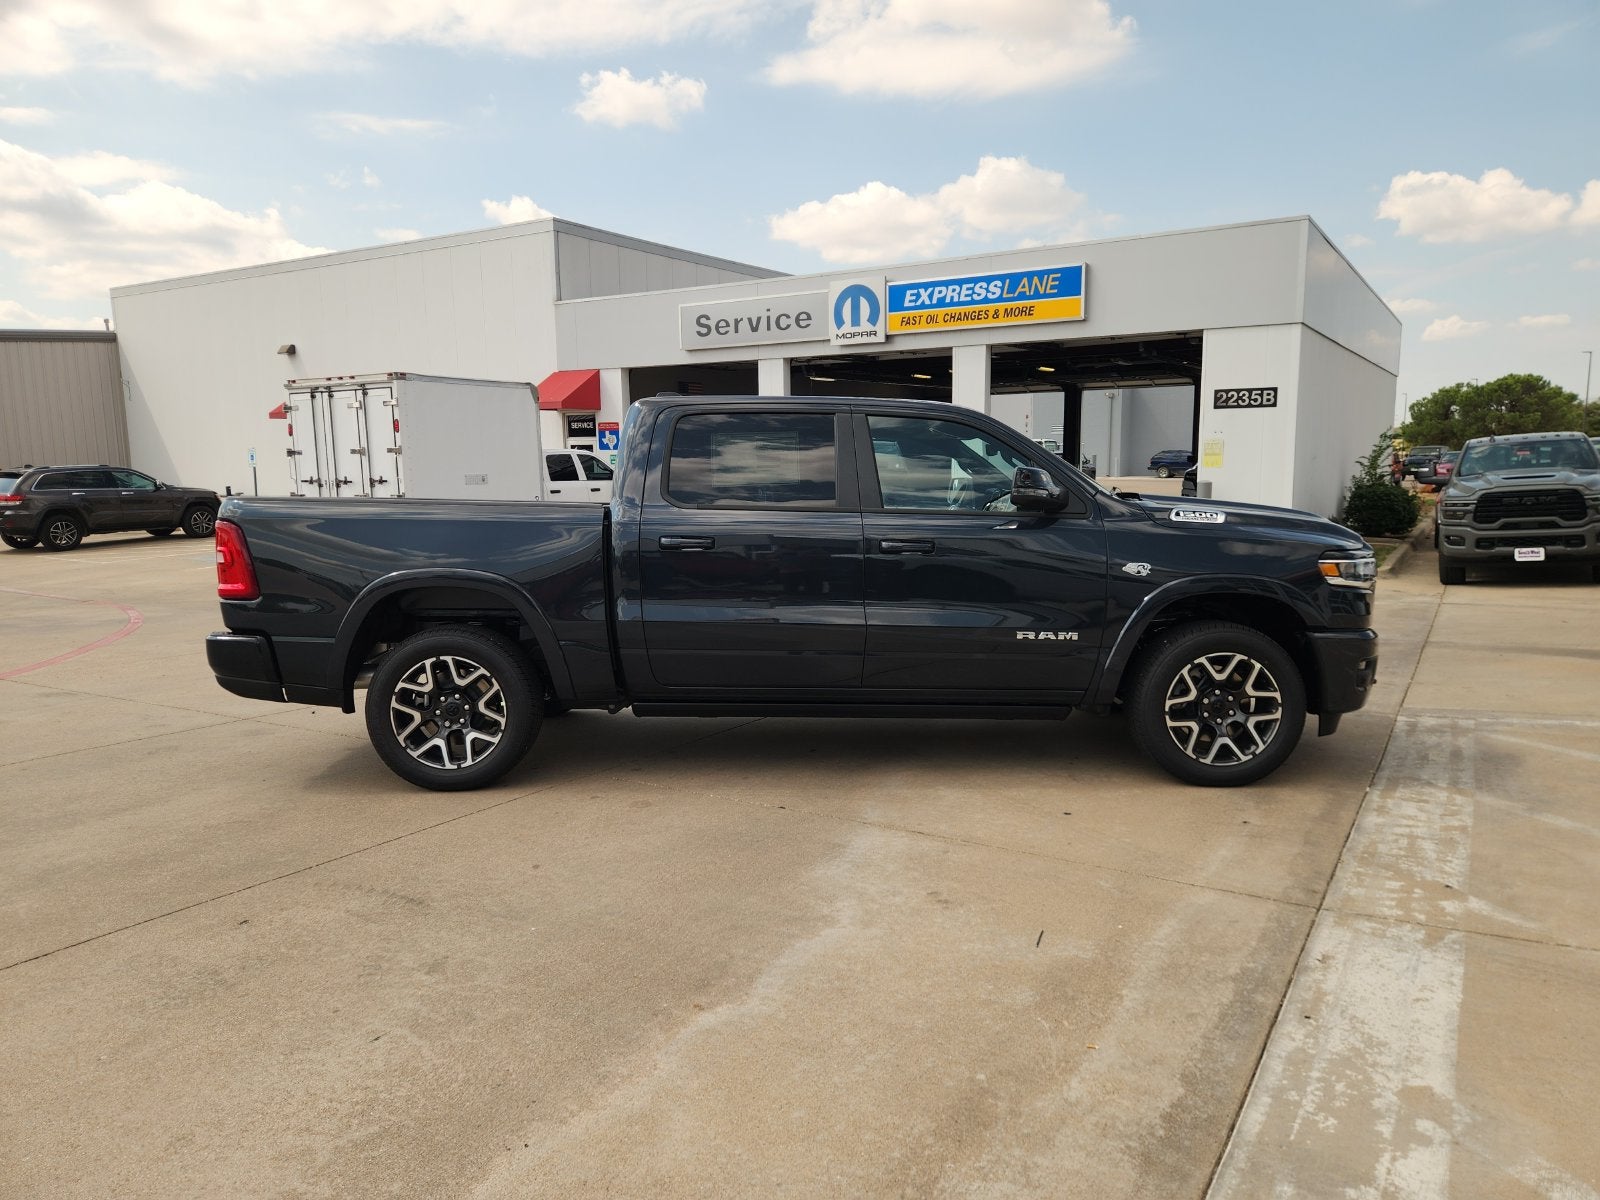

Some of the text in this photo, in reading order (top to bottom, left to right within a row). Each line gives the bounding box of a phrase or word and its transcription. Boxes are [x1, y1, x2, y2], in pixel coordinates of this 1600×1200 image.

[695, 308, 813, 338] Service
[900, 305, 1036, 327] FAST OIL CHANGES & MORE
[835, 330, 878, 340] MOPAR
[1216, 390, 1275, 406] 2235B
[1016, 631, 1079, 641] RAM
